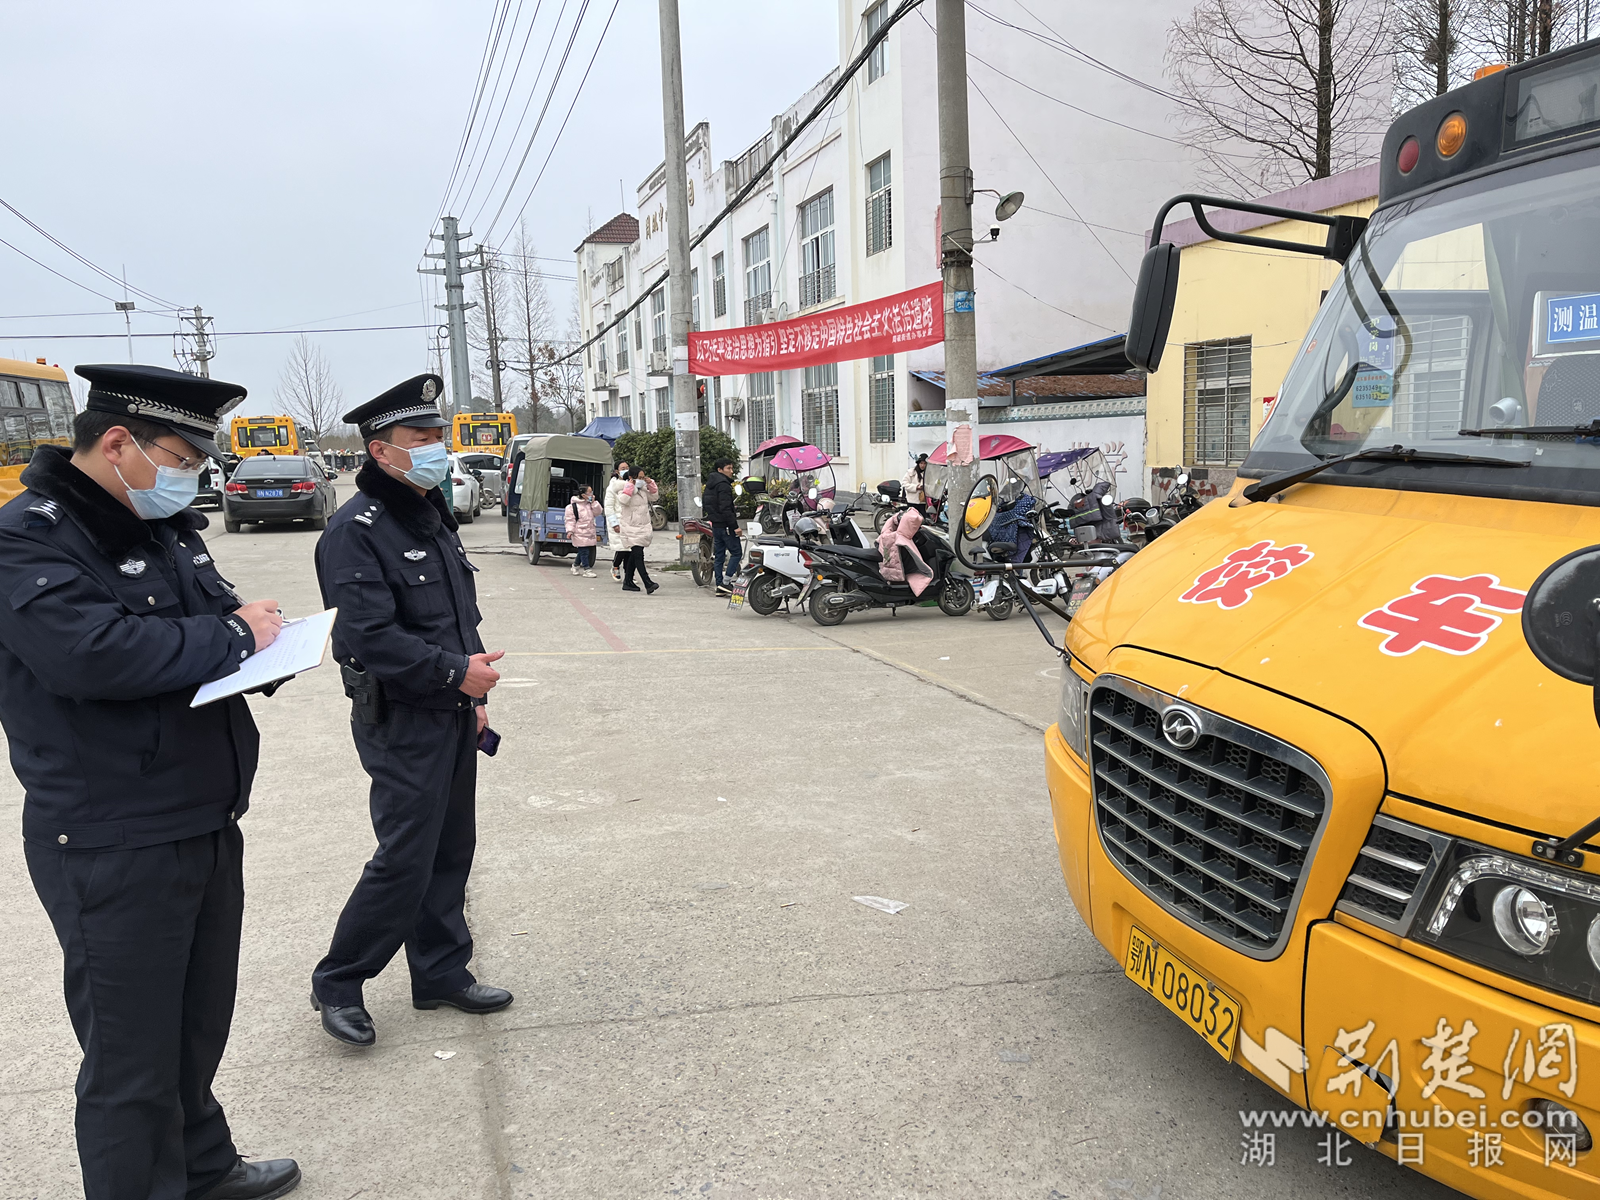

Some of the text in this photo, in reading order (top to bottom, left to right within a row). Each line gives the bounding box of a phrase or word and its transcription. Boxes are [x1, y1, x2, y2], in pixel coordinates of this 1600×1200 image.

[696, 295, 934, 363] 以习近平法治思想为指引 坚定不移走中国特色社会主义法治道路
[1553, 303, 1599, 333] 测温
[1178, 539, 1527, 657] 校车
[227, 619, 246, 637] POLICE
[446, 668, 456, 684] POLICE
